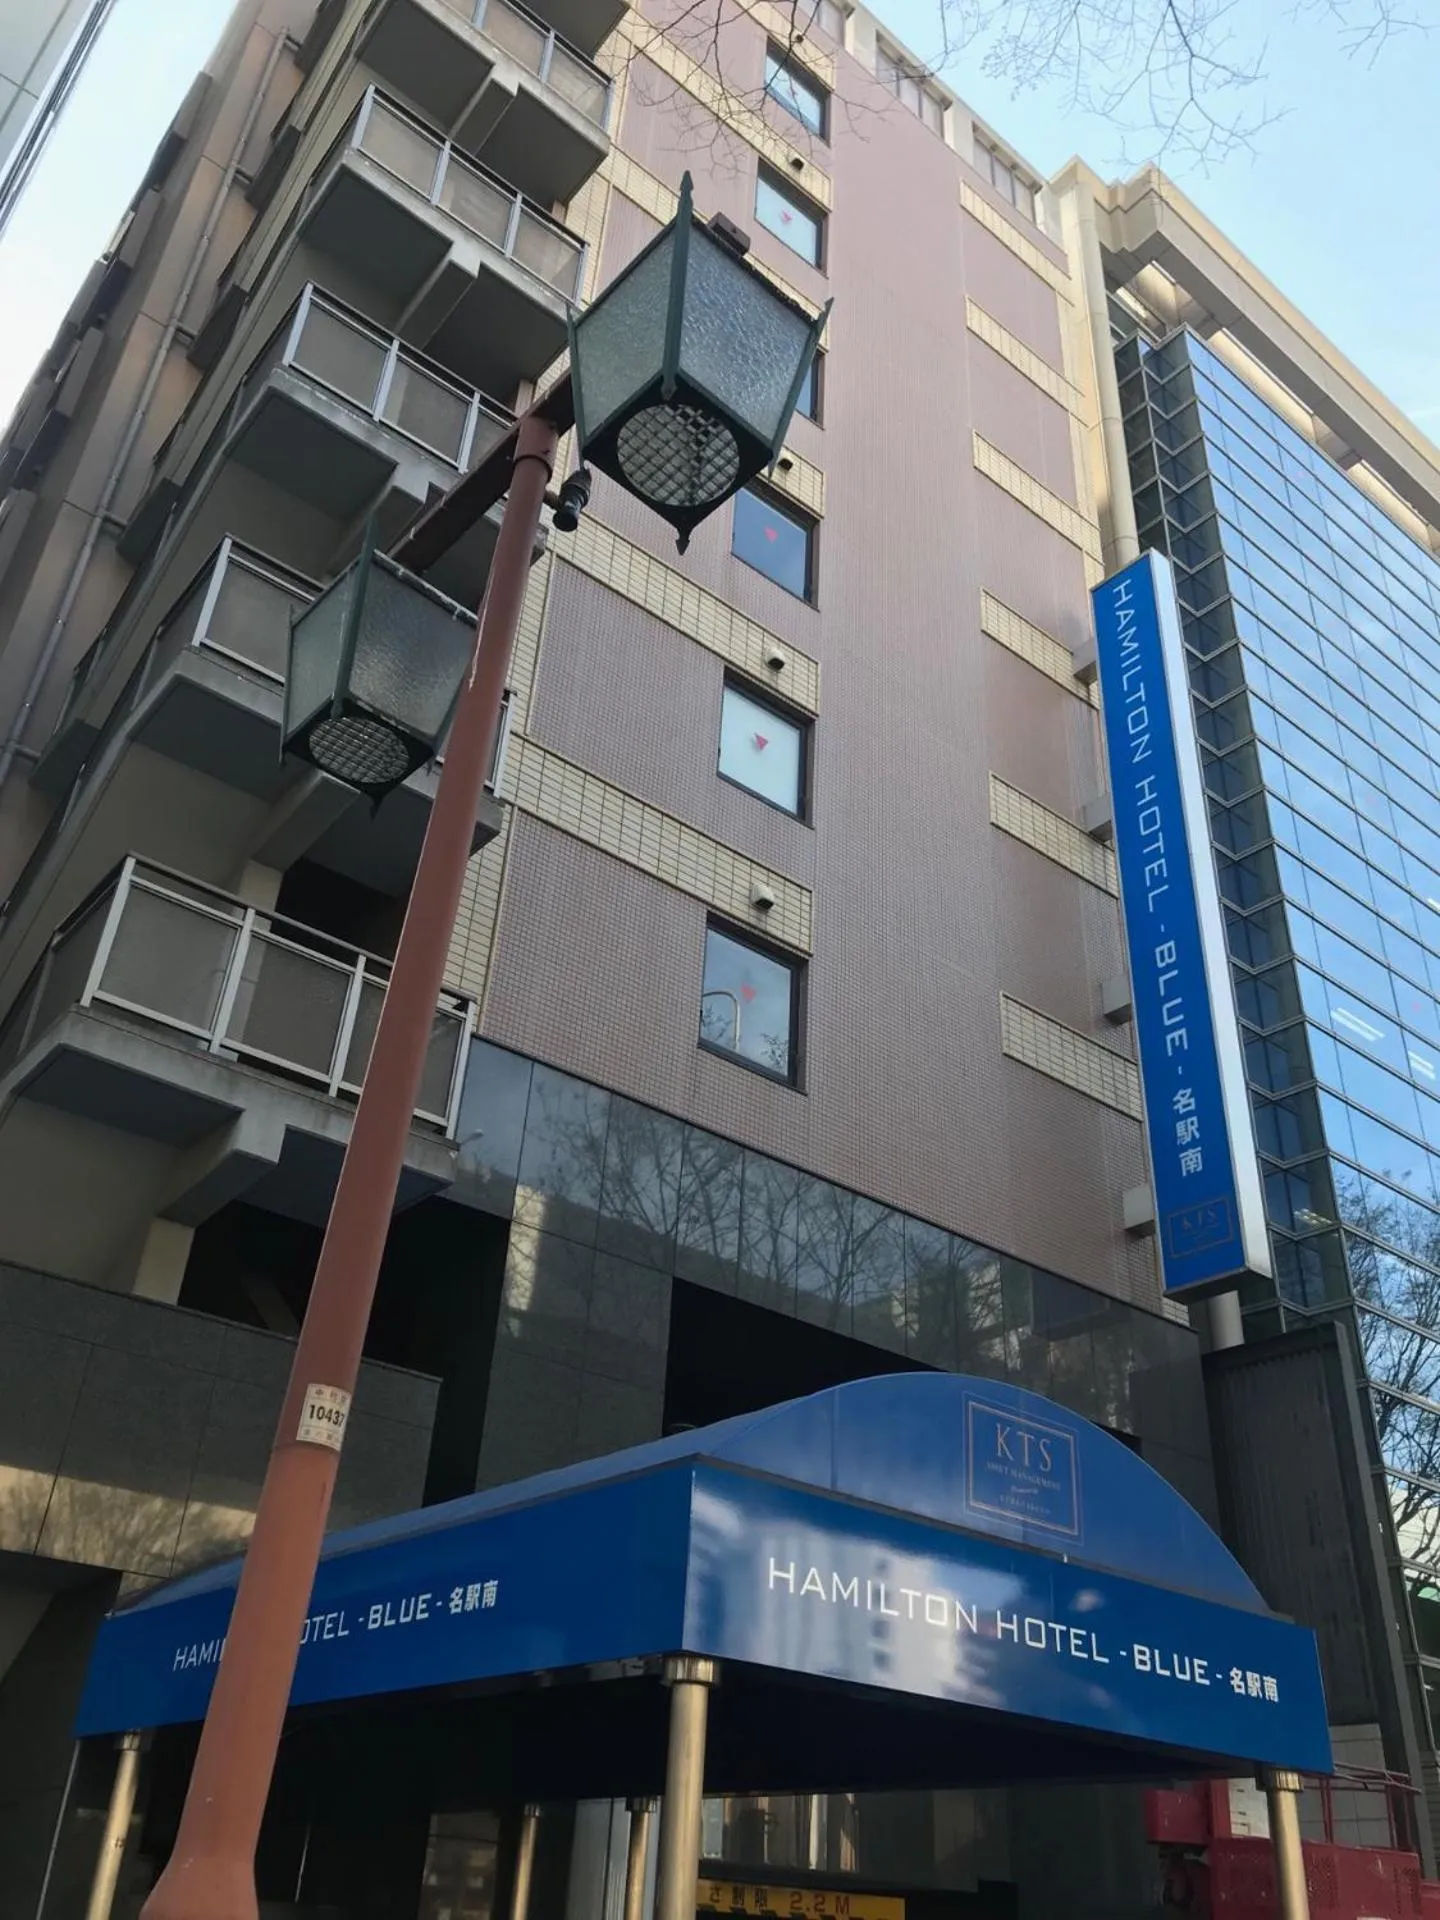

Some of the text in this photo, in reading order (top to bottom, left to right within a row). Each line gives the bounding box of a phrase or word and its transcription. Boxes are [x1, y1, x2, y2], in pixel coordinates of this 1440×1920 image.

[1112, 579, 1152, 764] HAMILTON
[1134, 774, 1170, 913] HOTEL
[1172, 1086, 1204, 1178] 名駅南
[995, 1422, 1052, 1473] KTS
[449, 1579, 499, 1615] 名駅南
[768, 1556, 978, 1634] HAMILTON
[996, 1609, 1110, 1664] HOTEL
[1229, 1666, 1280, 1703] 名駅南
[709, 1883, 769, 1911] さ制限
